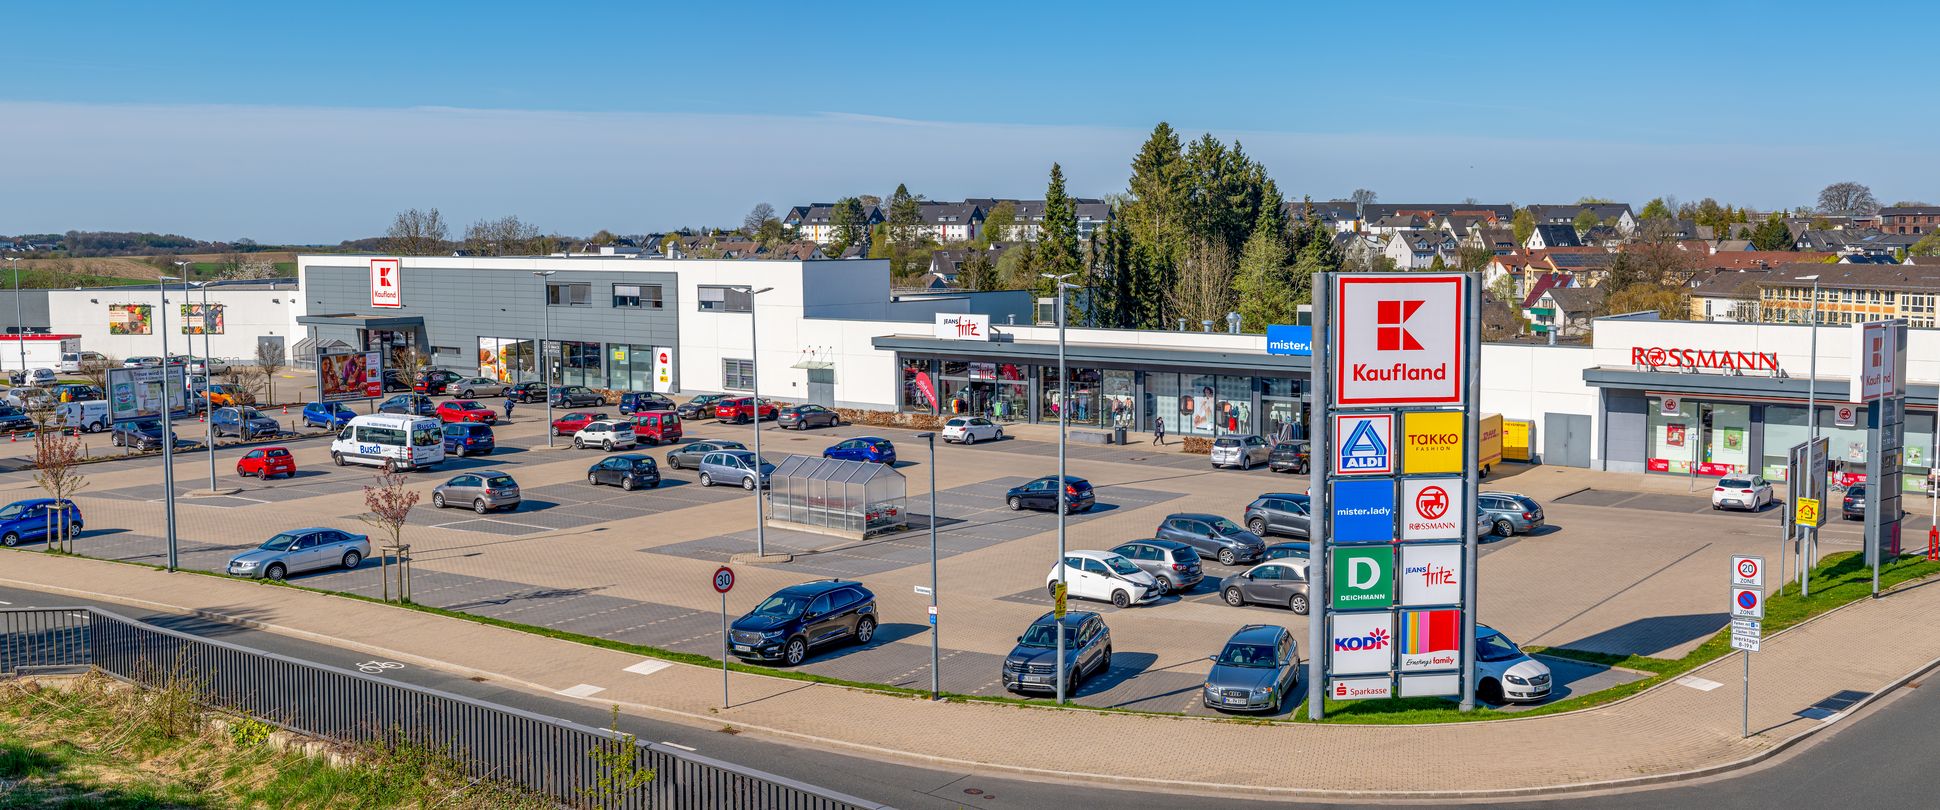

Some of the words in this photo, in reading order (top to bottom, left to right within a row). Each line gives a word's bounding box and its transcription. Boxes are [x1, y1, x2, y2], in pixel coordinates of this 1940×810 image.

[375, 290, 396, 298] Kaufland
[955, 315, 981, 337] fritz
[1631, 346, 1777, 371] ROSSMANN
[1352, 362, 1446, 381] Kaufland
[1865, 371, 1891, 387] Kauflnd
[417, 422, 437, 430] Busch
[360, 443, 381, 454] Busch
[1346, 457, 1383, 468] ALDI
[1337, 506, 1391, 517] mister.lady
[1408, 522, 1456, 531] ROSSMANN
[1742, 564, 1754, 573] 20
[717, 573, 730, 587] 30
[1405, 566, 1427, 575] JEANS
[1421, 562, 1457, 588] fritz
[1432, 656, 1454, 665] family
[1350, 687, 1388, 697] Sparkasse
